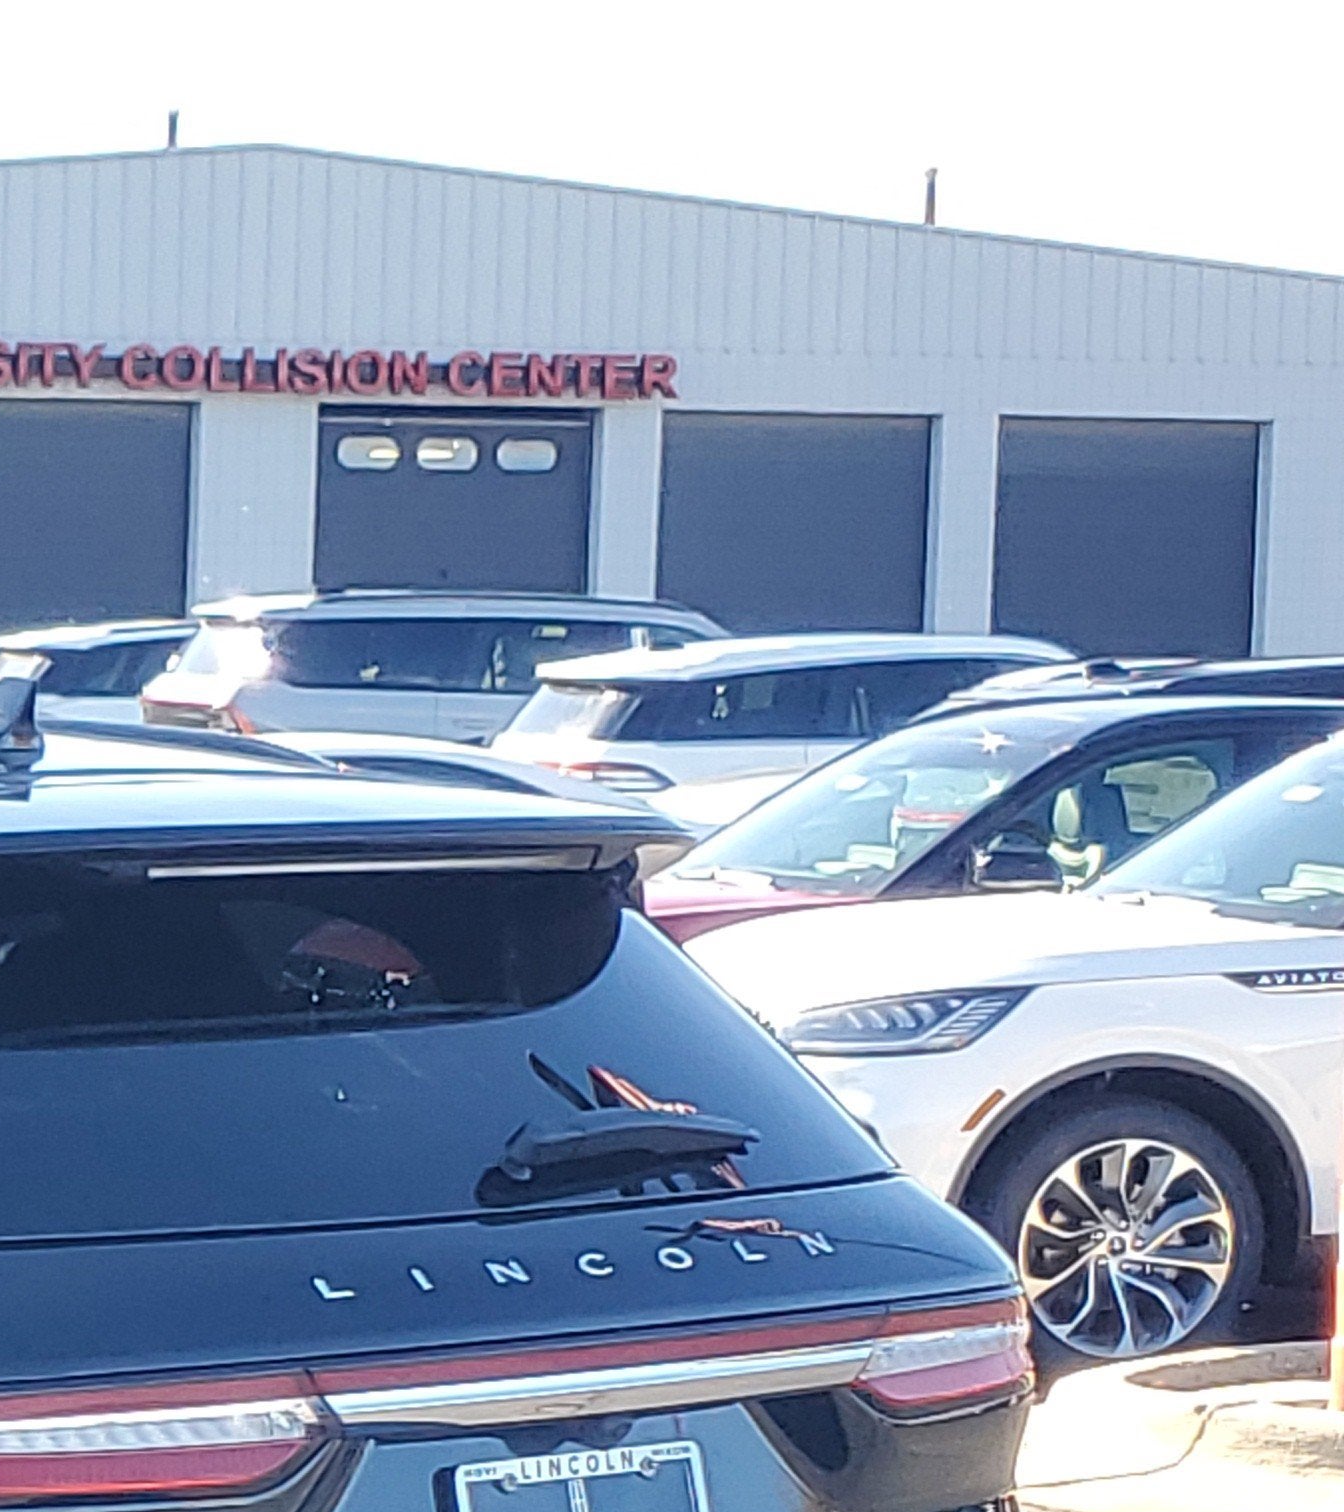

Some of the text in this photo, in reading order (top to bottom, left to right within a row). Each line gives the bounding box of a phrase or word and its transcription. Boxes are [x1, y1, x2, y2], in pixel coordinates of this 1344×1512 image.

[120, 343, 429, 396] COLLISION
[447, 350, 679, 400] CENTER
[313, 1231, 836, 1300] LINCOLN
[519, 1449, 634, 1480] LINCOLN
